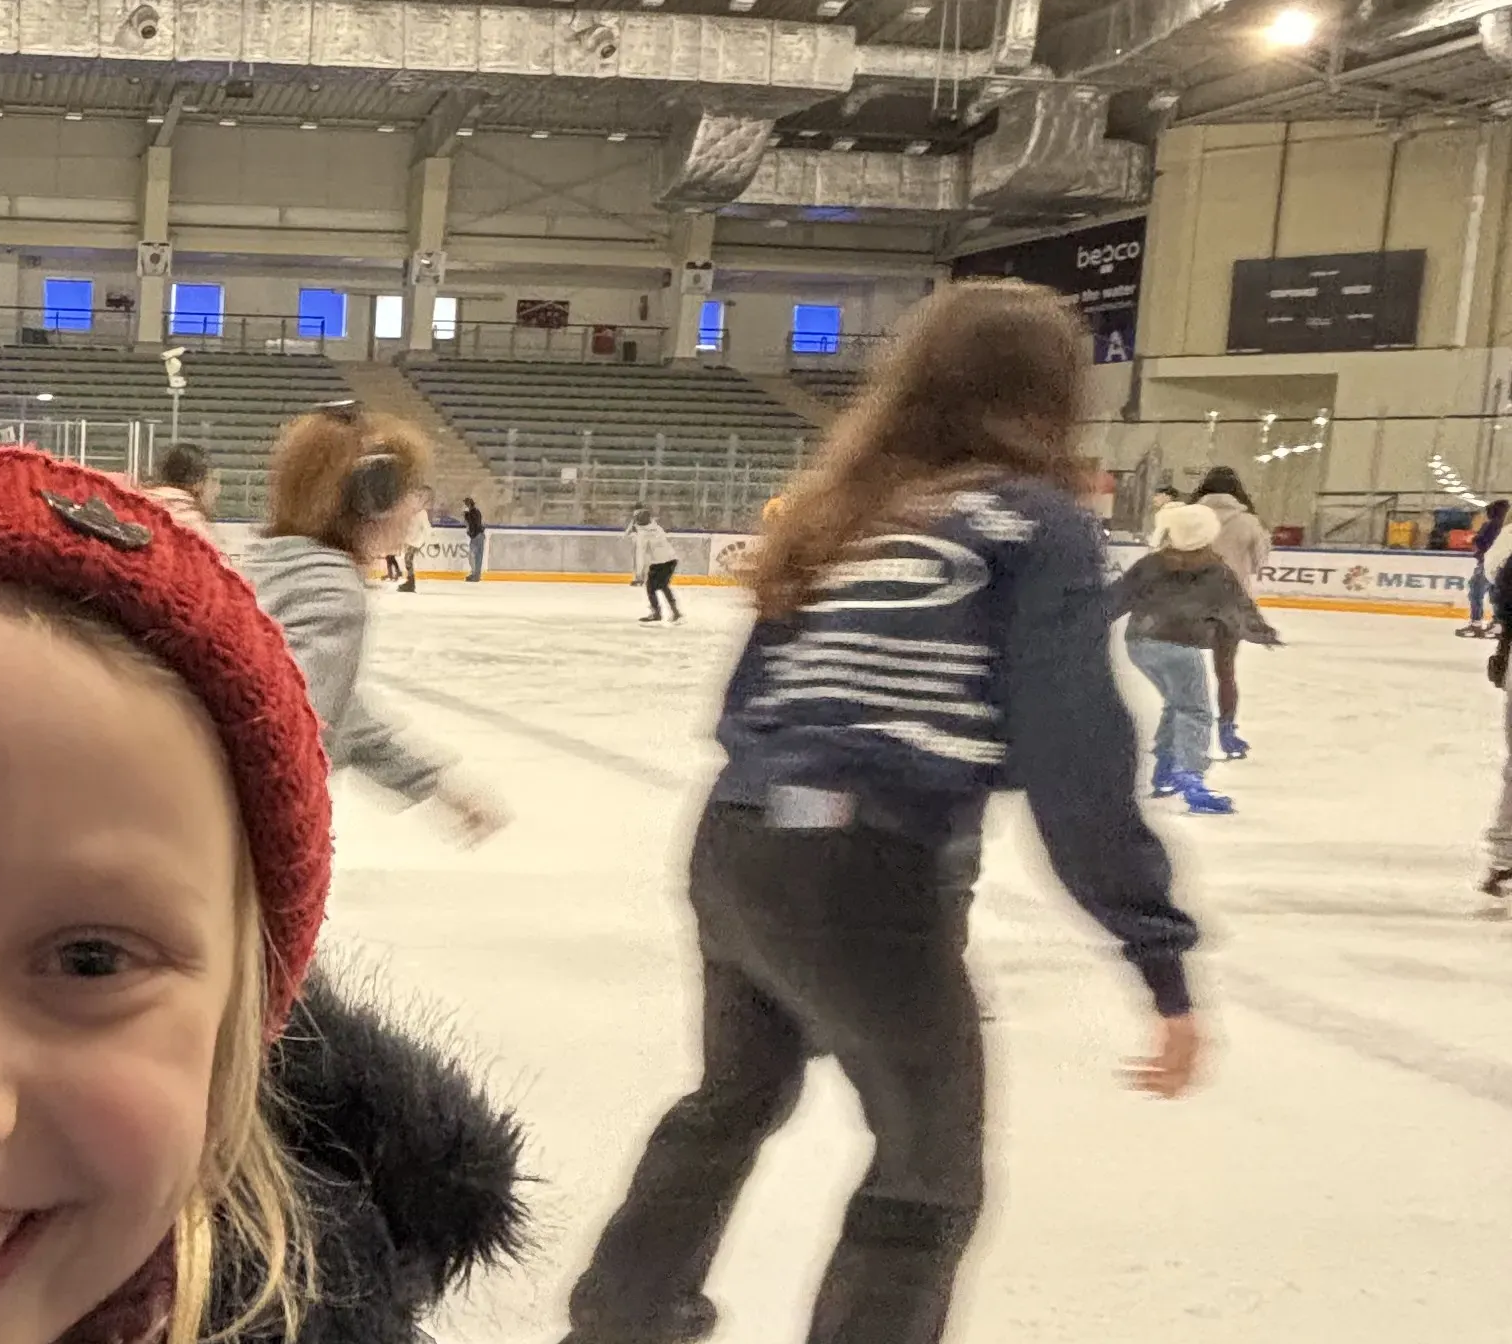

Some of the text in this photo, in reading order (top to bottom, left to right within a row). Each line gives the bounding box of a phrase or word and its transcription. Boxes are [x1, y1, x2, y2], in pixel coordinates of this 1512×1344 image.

[1104, 330, 1128, 362] A
[1256, 565, 1336, 585] RZET
[1376, 571, 1465, 591] METR
